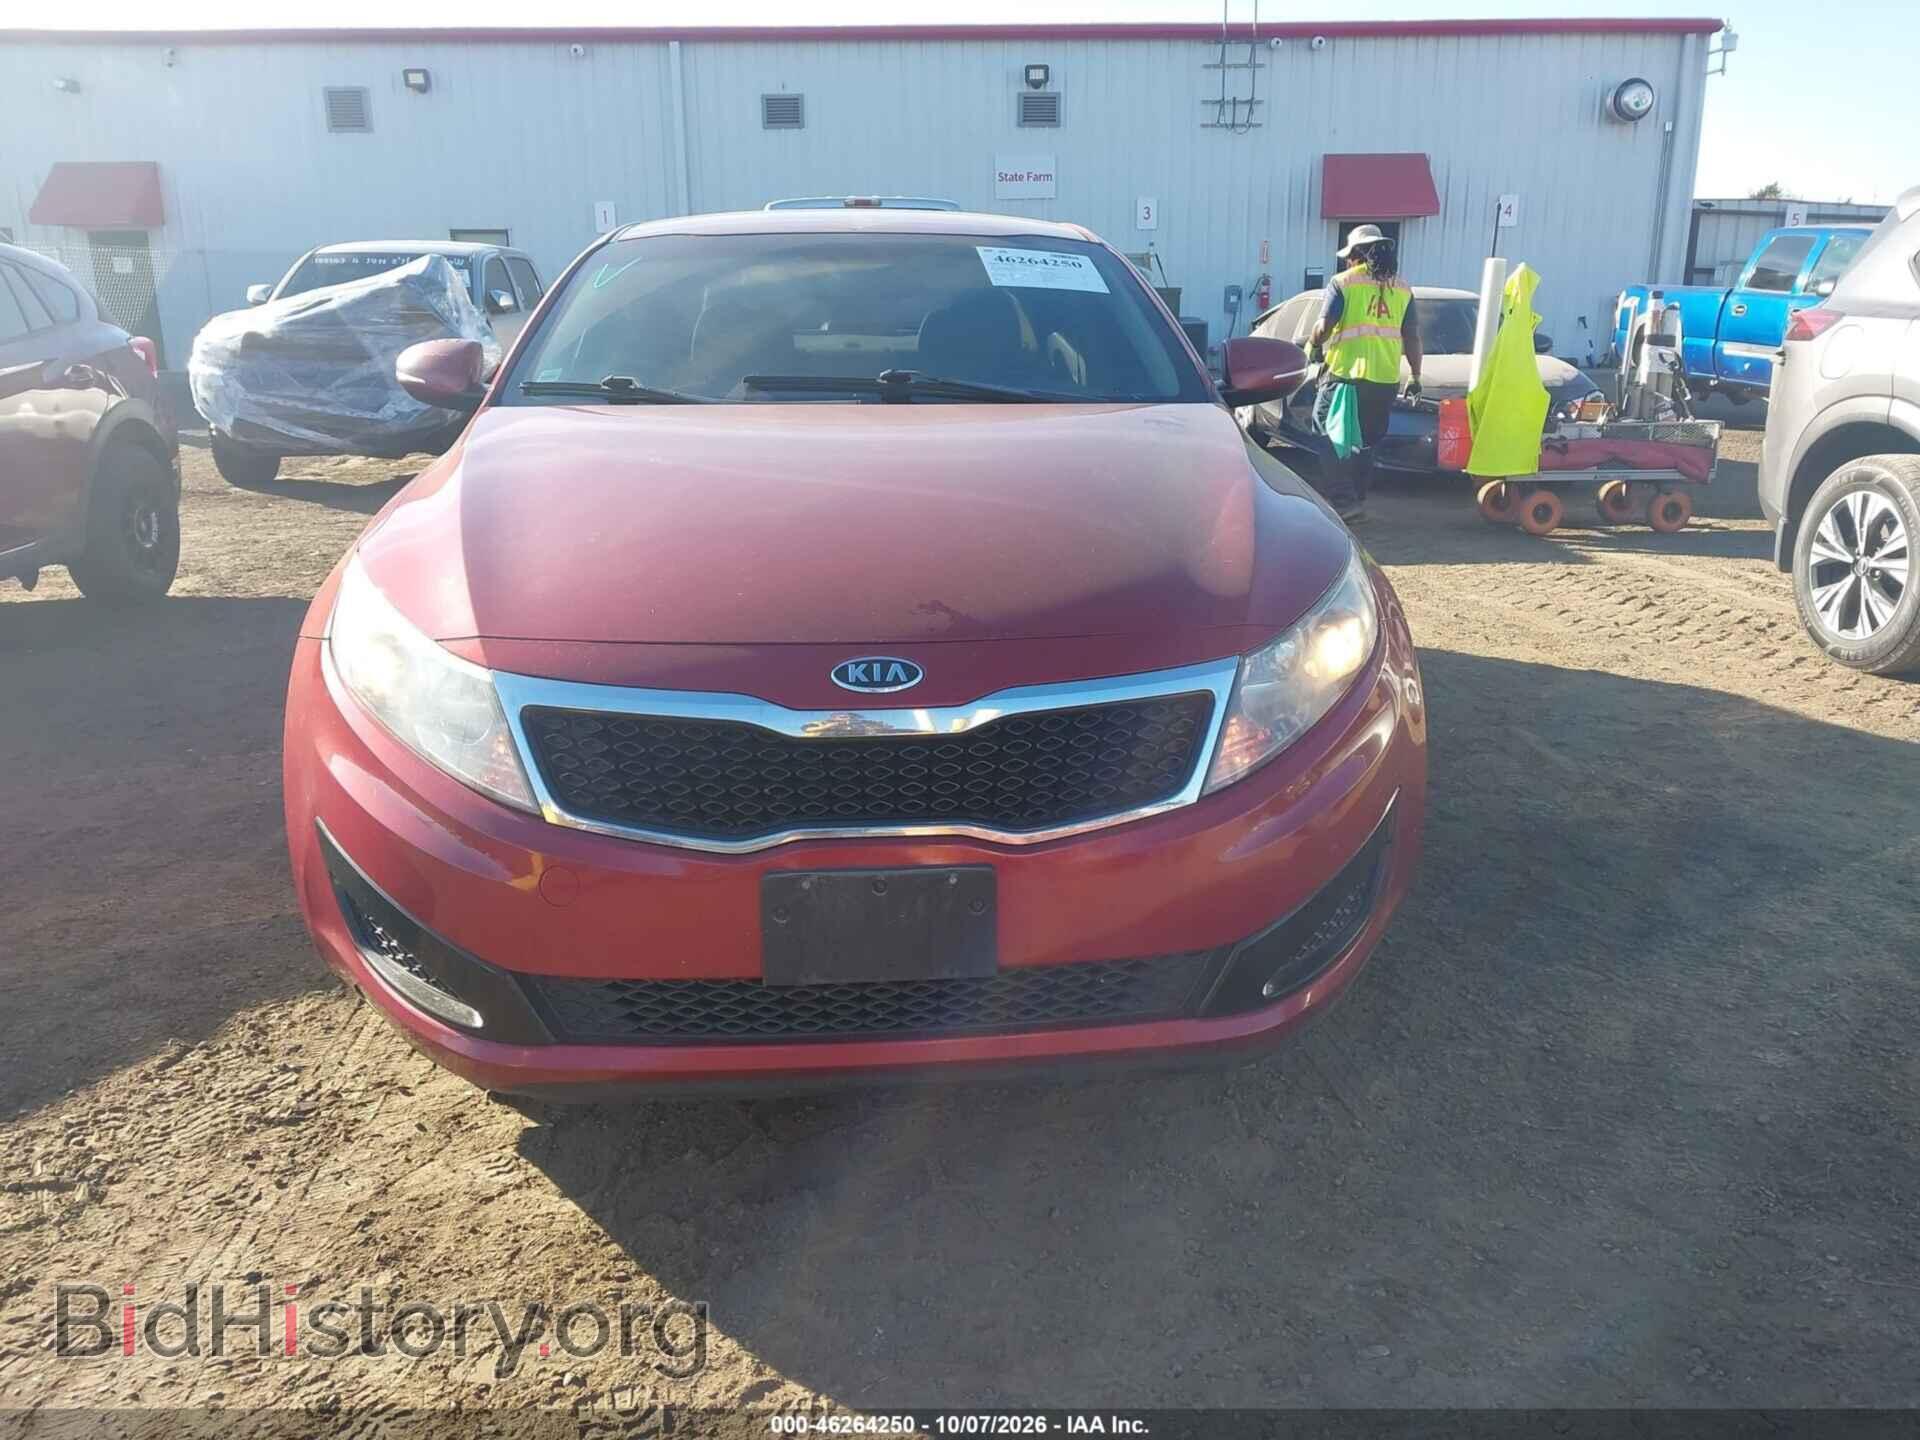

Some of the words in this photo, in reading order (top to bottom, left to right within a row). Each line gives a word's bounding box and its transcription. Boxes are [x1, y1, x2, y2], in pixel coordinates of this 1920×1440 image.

[998, 171, 1024, 182] State
[1026, 171, 1053, 182] Farm
[1143, 206, 1151, 220] 3
[1503, 203, 1512, 217] 4
[1792, 213, 1800, 226] 5
[994, 255, 1083, 269] 46264250
[848, 663, 908, 682] KIA
